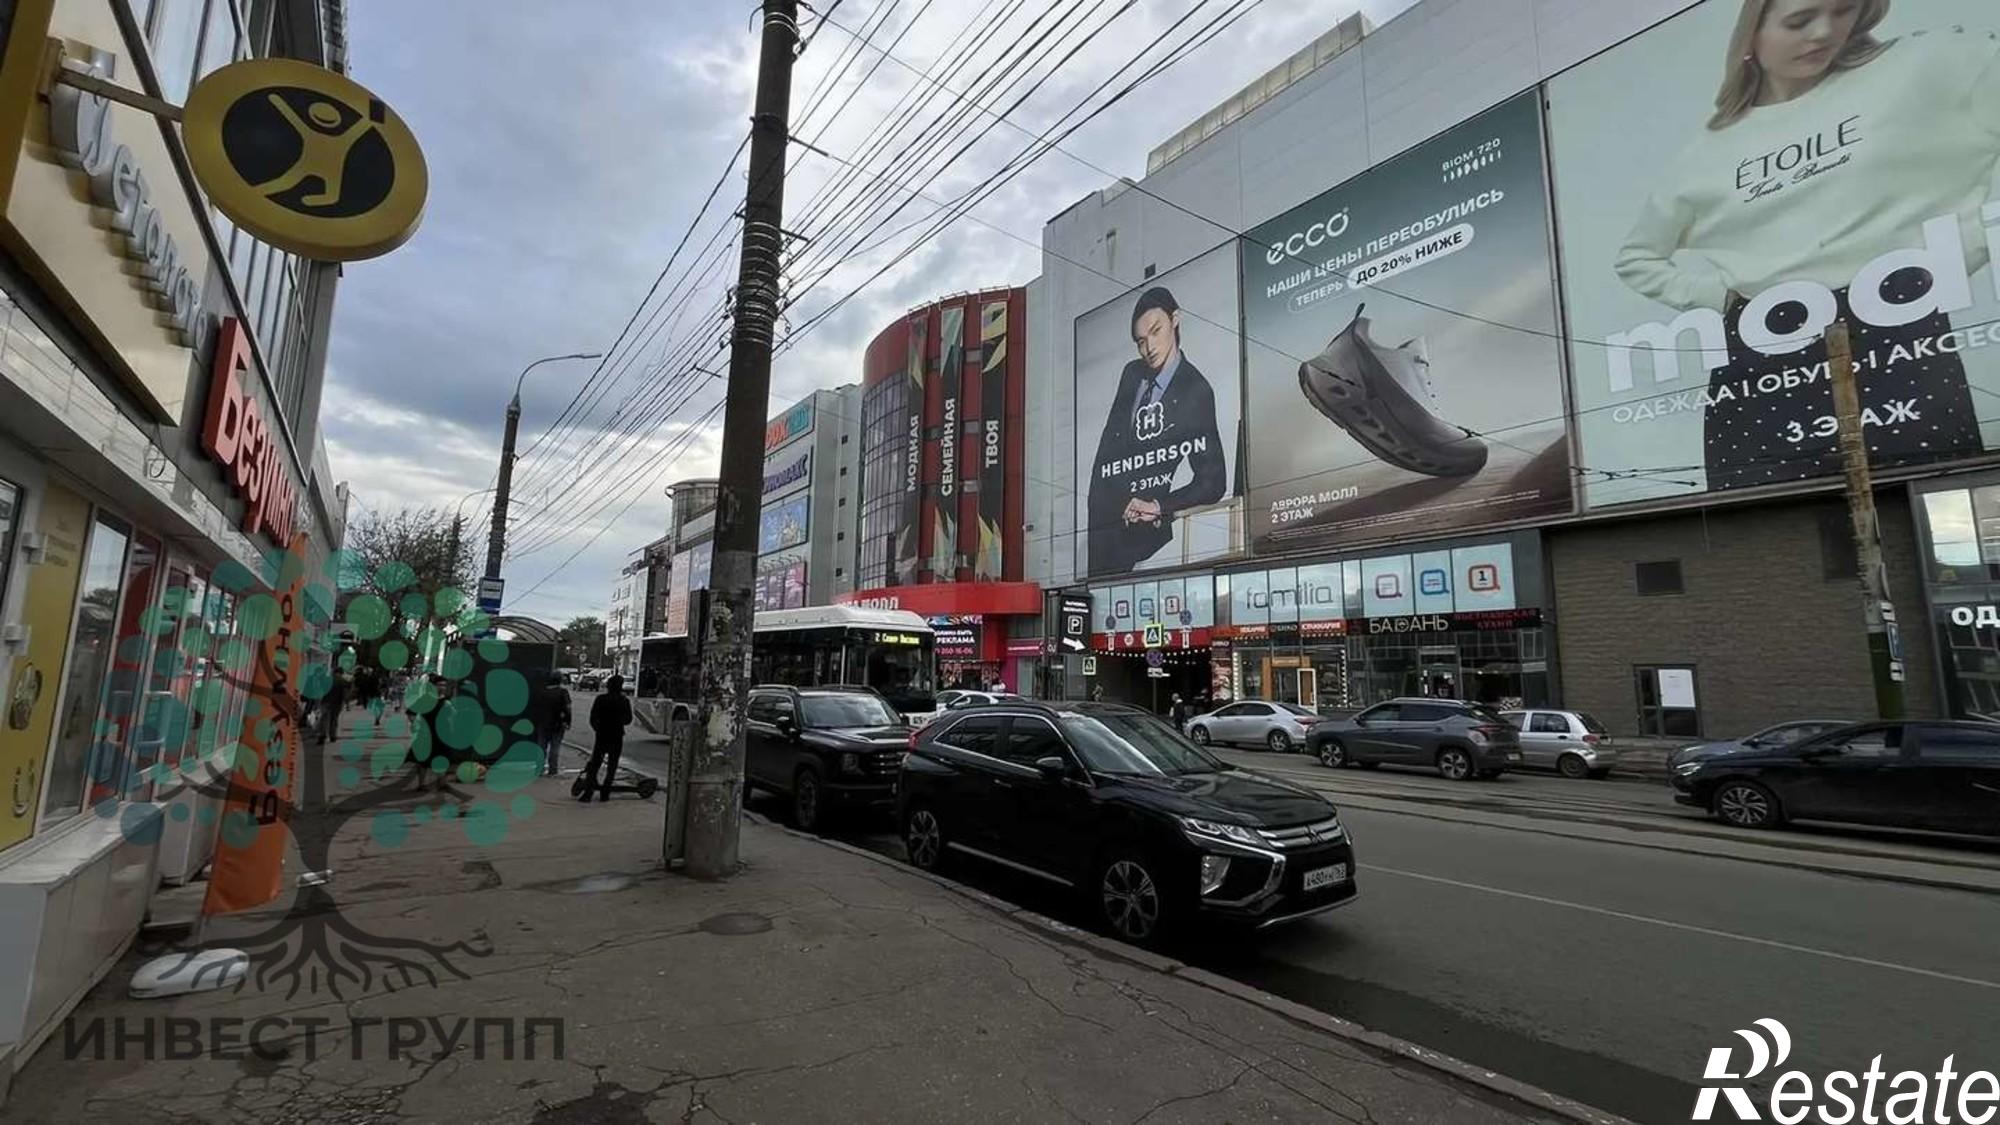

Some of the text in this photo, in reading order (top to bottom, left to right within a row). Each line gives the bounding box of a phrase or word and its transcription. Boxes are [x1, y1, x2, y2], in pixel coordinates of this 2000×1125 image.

[1441, 137, 1501, 172] BIOM 720
[1735, 114, 1864, 190] ÉTOILE
[1266, 208, 1349, 265] ecco
[1266, 187, 1505, 298] НАШИ ЦЕНЫ ПЕРЕОБУЛИСЬ
[1295, 230, 1464, 308] ТЕПЕРЬ ДО 20% НИЖЕ
[1612, 384, 1736, 424] ОДЕЖДА
[1757, 361, 1860, 393] ОБУ
[214, 318, 297, 548] Безумно
[941, 398, 956, 497] СЕМЕЙНАЯ
[985, 419, 999, 469] ТВОЯ
[1786, 399, 1921, 443] 3 ЭАЖ
[906, 414, 920, 493] МОДНАЯ
[1101, 436, 1208, 479] HENDERSON
[1130, 473, 1174, 493] 2 ЭТАЖ
[1270, 485, 1359, 512] АВРОРА МОЛЛ
[1271, 507, 1314, 525] 2 ЭТАЖ
[1246, 576, 1334, 610] familia
